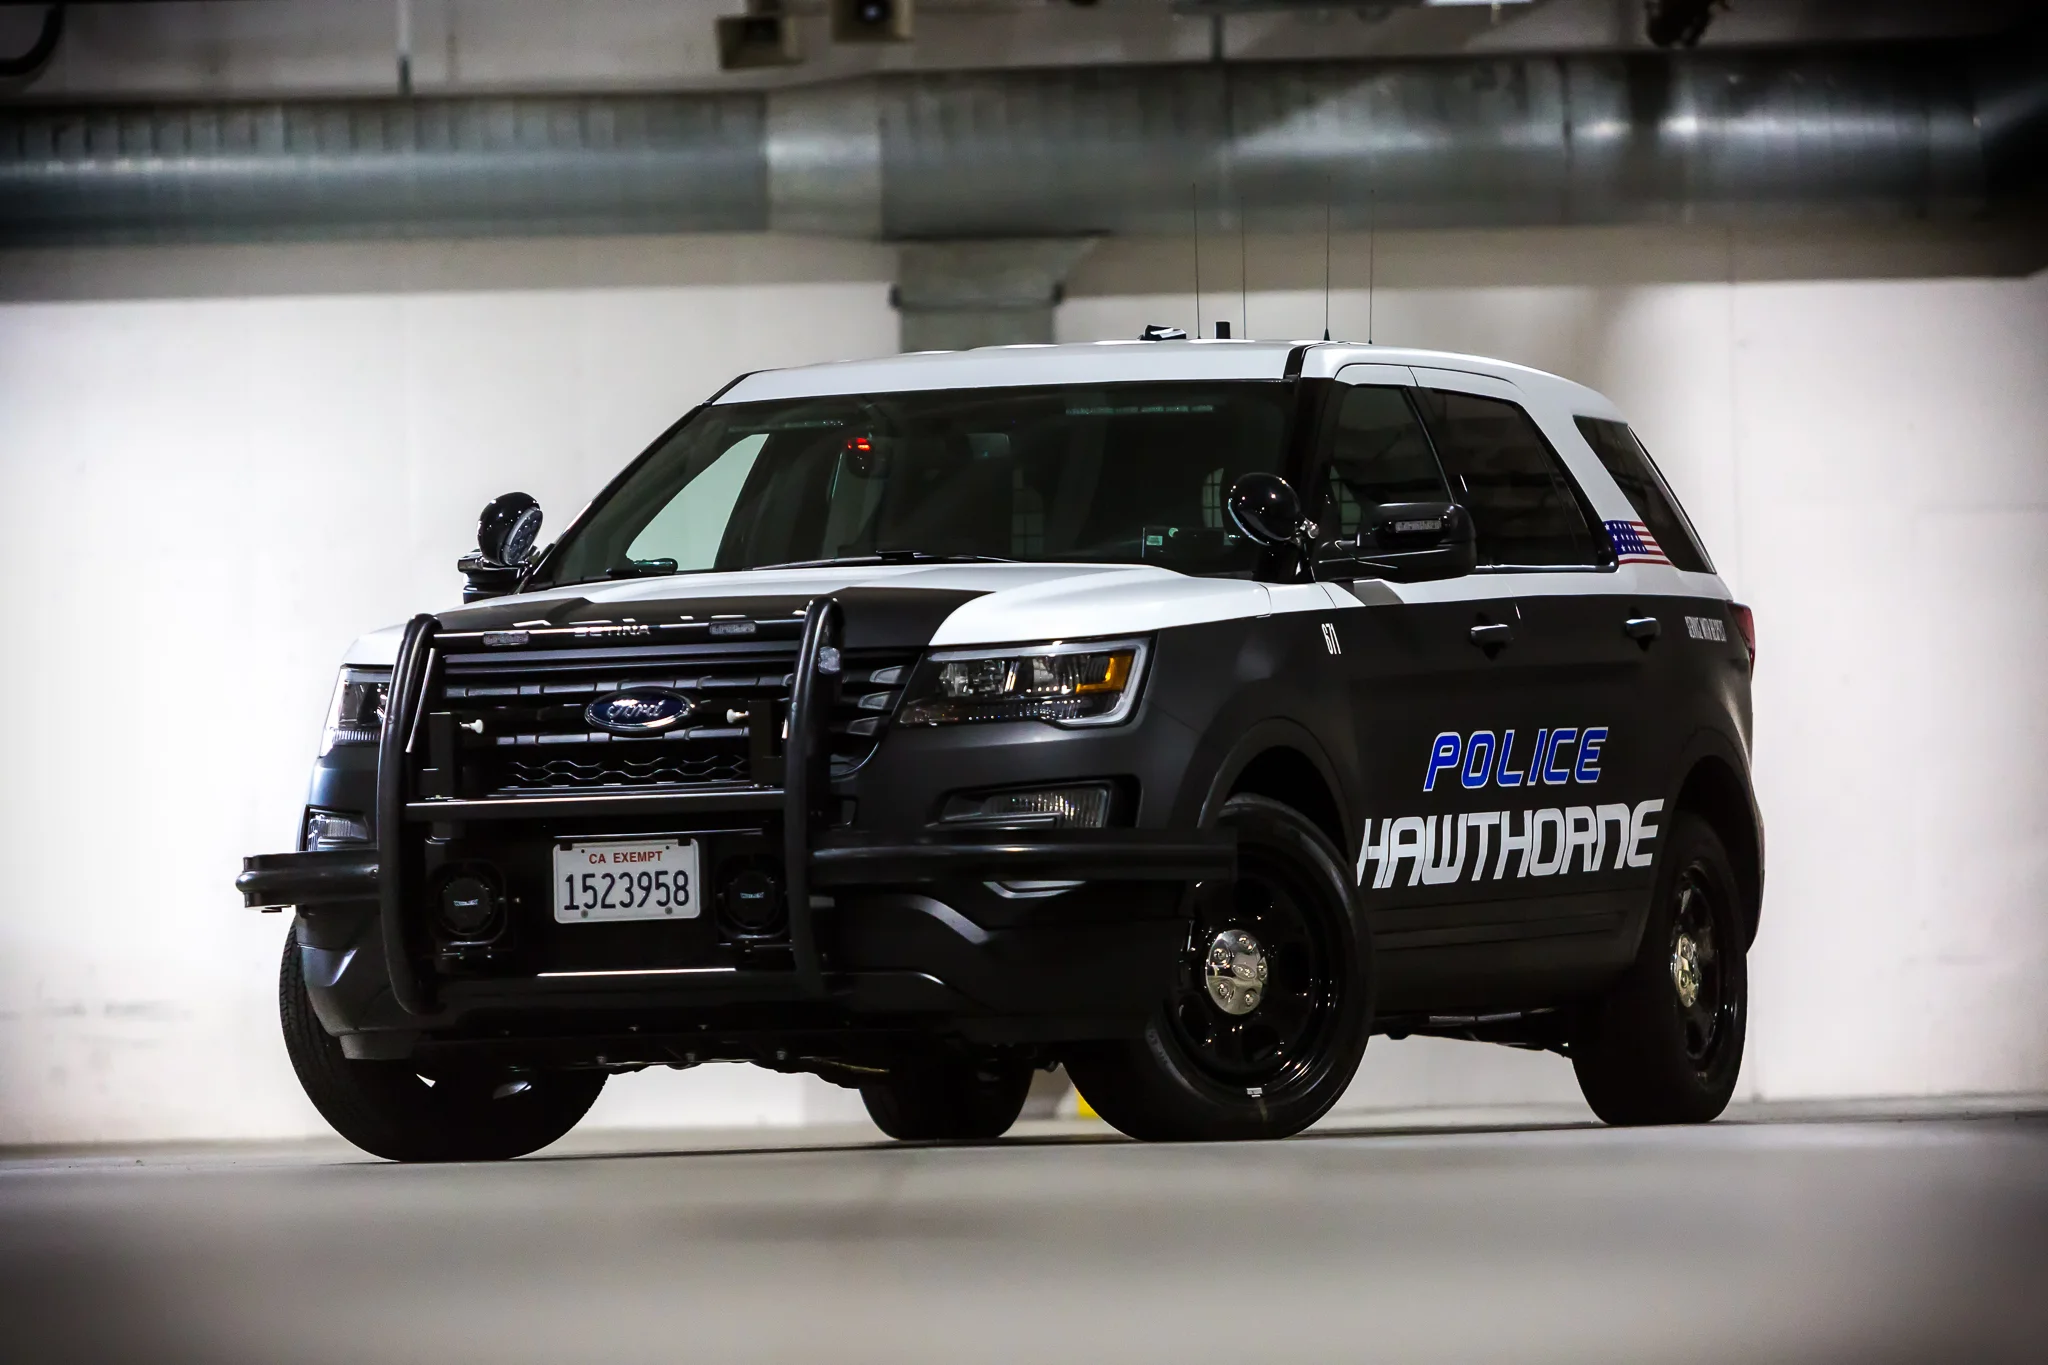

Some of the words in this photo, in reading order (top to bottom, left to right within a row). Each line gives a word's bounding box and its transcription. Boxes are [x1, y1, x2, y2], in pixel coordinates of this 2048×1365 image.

[1321, 623, 1341, 654] 671
[607, 699, 665, 718] Ford
[1423, 727, 1608, 791] POLICE
[588, 854, 606, 864] CA
[613, 851, 663, 863] EXEMPT
[1356, 799, 1664, 888] HAWTHORNE
[564, 870, 689, 910] 1523958
